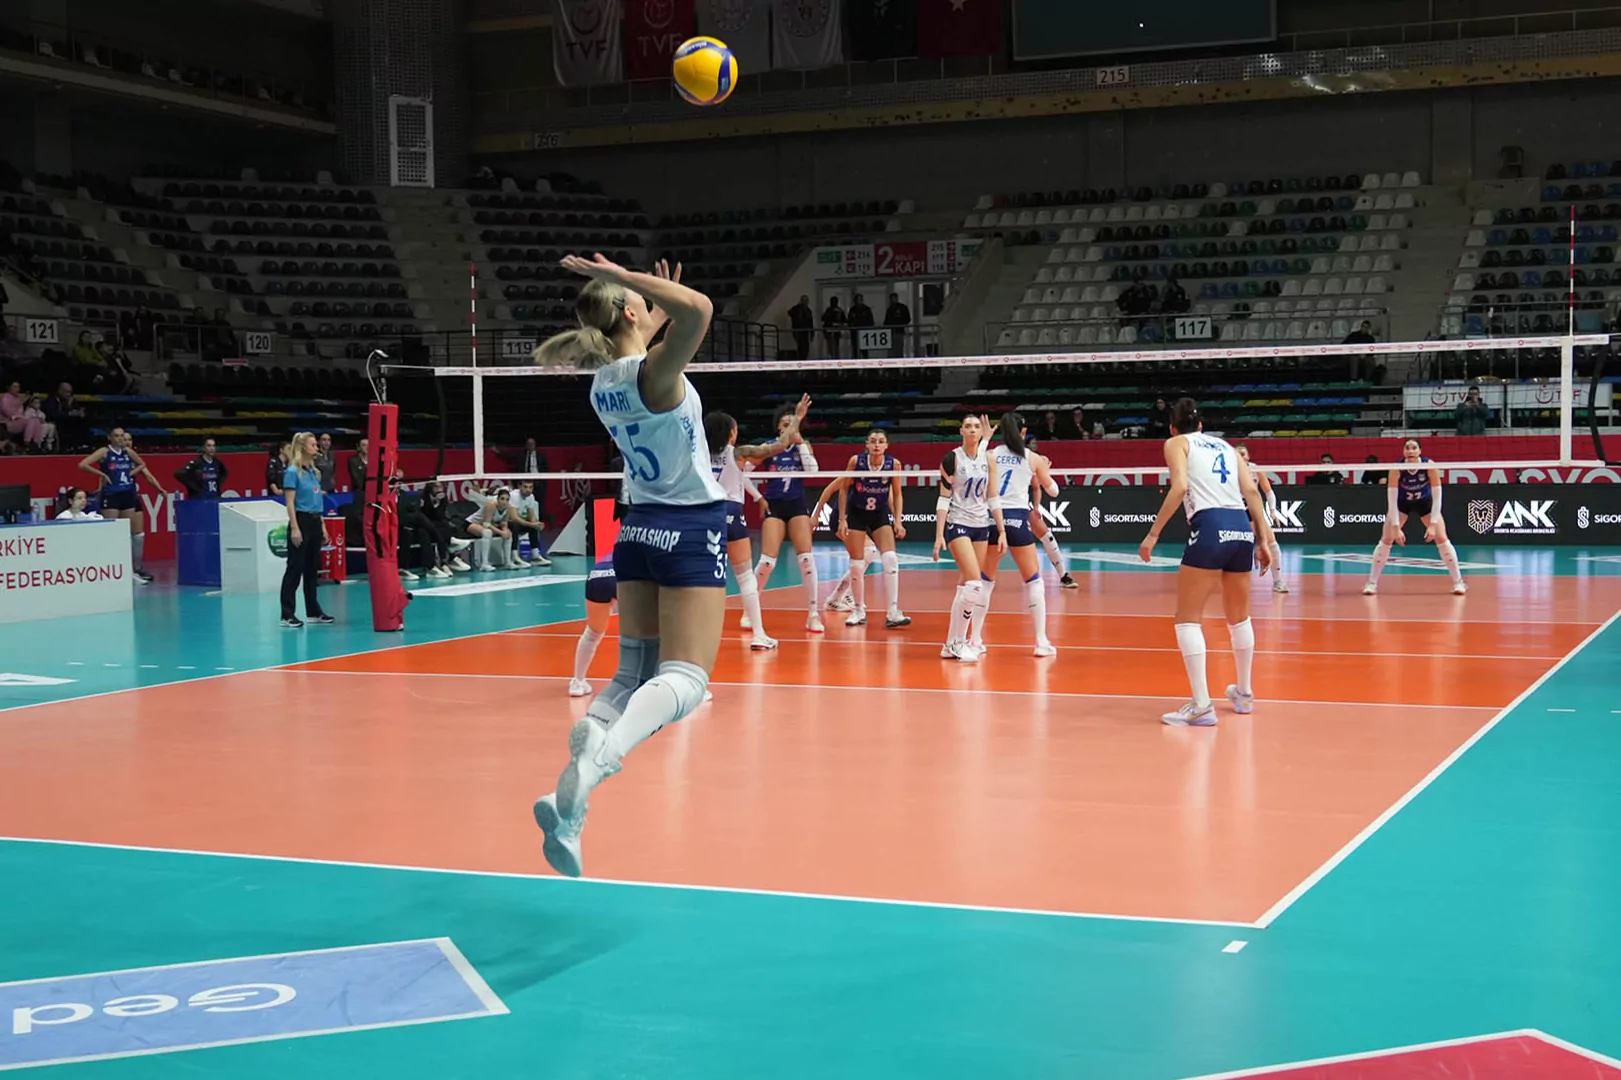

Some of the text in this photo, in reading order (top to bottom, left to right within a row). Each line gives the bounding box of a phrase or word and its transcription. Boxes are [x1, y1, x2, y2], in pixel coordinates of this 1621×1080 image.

[566, 41, 608, 60] TVF
[1100, 68, 1126, 83] 215
[877, 245, 894, 275] 2
[30, 322, 55, 339] 121
[1179, 320, 1207, 335] 117
[248, 335, 269, 350] 120
[862, 332, 888, 346] 118
[506, 342, 532, 355] 119
[1447, 391, 1467, 402] TV
[1553, 389, 1577, 401] TF
[1212, 453, 1231, 484] 4
[999, 469, 1013, 496] 1
[865, 497, 877, 511] 8
[1495, 500, 1555, 527] ANK
